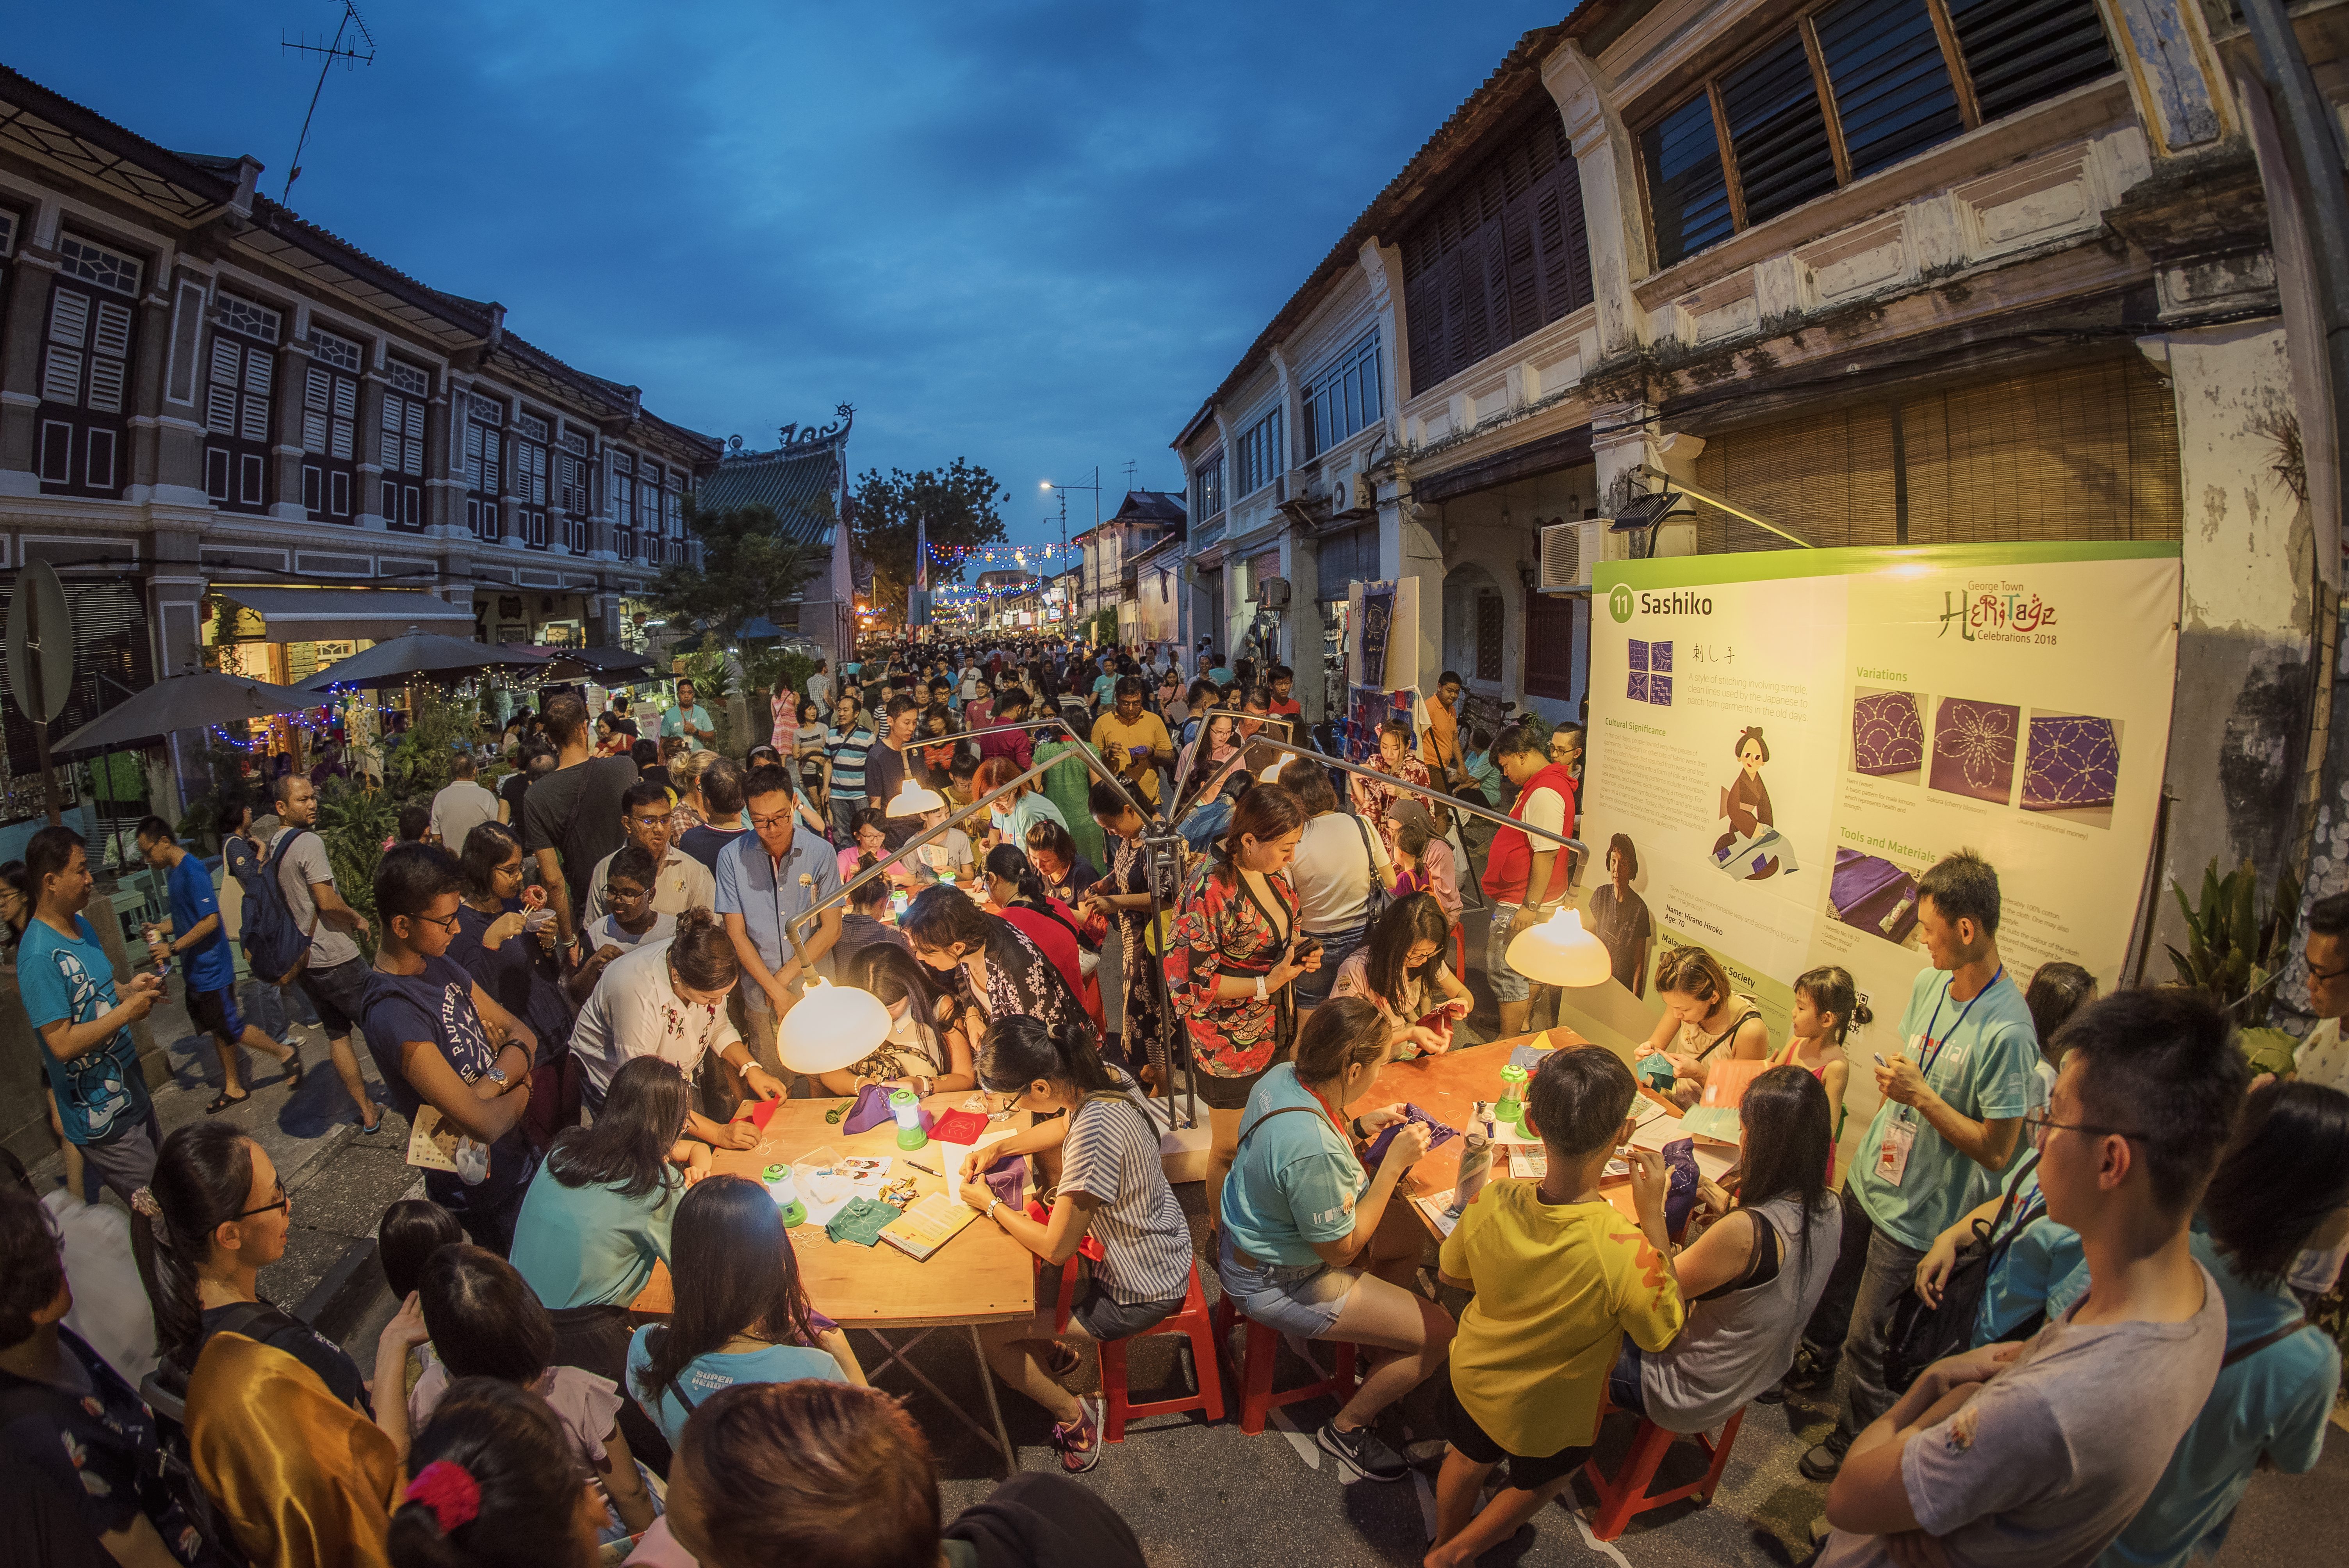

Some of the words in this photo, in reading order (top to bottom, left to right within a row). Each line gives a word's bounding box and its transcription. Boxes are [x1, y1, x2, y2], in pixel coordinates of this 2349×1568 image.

[1968, 580, 1998, 593] George
[2001, 581, 2023, 591] Town
[1615, 595, 1628, 614] 11
[1641, 592, 1712, 615] Sashiko
[1978, 630, 2030, 643] Celebrations
[2035, 634, 2057, 645] 2018
[1692, 643, 1735, 664] 刺し子
[1857, 668, 1907, 681] Variations
[1694, 675, 1709, 683] style
[1718, 677, 1747, 688] stitching
[1748, 680, 1779, 692] involving
[1781, 684, 1807, 695] simple,
[1688, 685, 1704, 693] clean
[1706, 687, 1720, 695] lines
[1739, 691, 1748, 701] by
[1763, 695, 1798, 706] Japanese
[1720, 702, 1753, 712] garments
[1789, 712, 1808, 722] days.
[1605, 718, 1627, 729] Cultural
[1629, 723, 1666, 736] Significance
[1623, 744, 1642, 752] Tablecloth
[1632, 772, 1649, 780] stitching
[1682, 785, 1706, 796] mountains,
[1859, 780, 1874, 789] (wave)
[1858, 798, 1881, 807] represents
[1944, 800, 1962, 809] (cherry
[1963, 804, 1987, 816] blossom)
[1613, 806, 1629, 816] coasters,
[1630, 811, 1646, 820] blankets
[1655, 820, 1677, 831] tablecloths.
[2035, 822, 2066, 834] (traditional
[2066, 831, 2089, 841] money)
[1841, 828, 1864, 842] Tools
[1867, 836, 1886, 848] and
[1887, 840, 1936, 864] Materials
[1677, 896, 1705, 913] imagination."
[1665, 913, 1676, 924] Age:
[1678, 919, 1685, 927] 70
[1666, 904, 1683, 918] Name:
[1684, 912, 1703, 927] Hirano
[1704, 921, 1723, 936] Hiroko
[1670, 884, 1679, 893] "Sew
[1685, 892, 1694, 900] your
[1706, 900, 1733, 916] comfortable
[1734, 913, 1744, 922] way
[1755, 921, 1780, 938] according
[1787, 936, 1798, 945] your
[1662, 933, 1686, 948] Malay
[1823, 939, 1836, 949] Cotton
[1824, 933, 1838, 941] Cotton
[1838, 939, 1852, 947] thread
[1729, 967, 1756, 989] Society
[460, 1064, 479, 1086] CAM
[691, 1377, 729, 1390] HERO
[695, 1370, 734, 1384] SUPER
